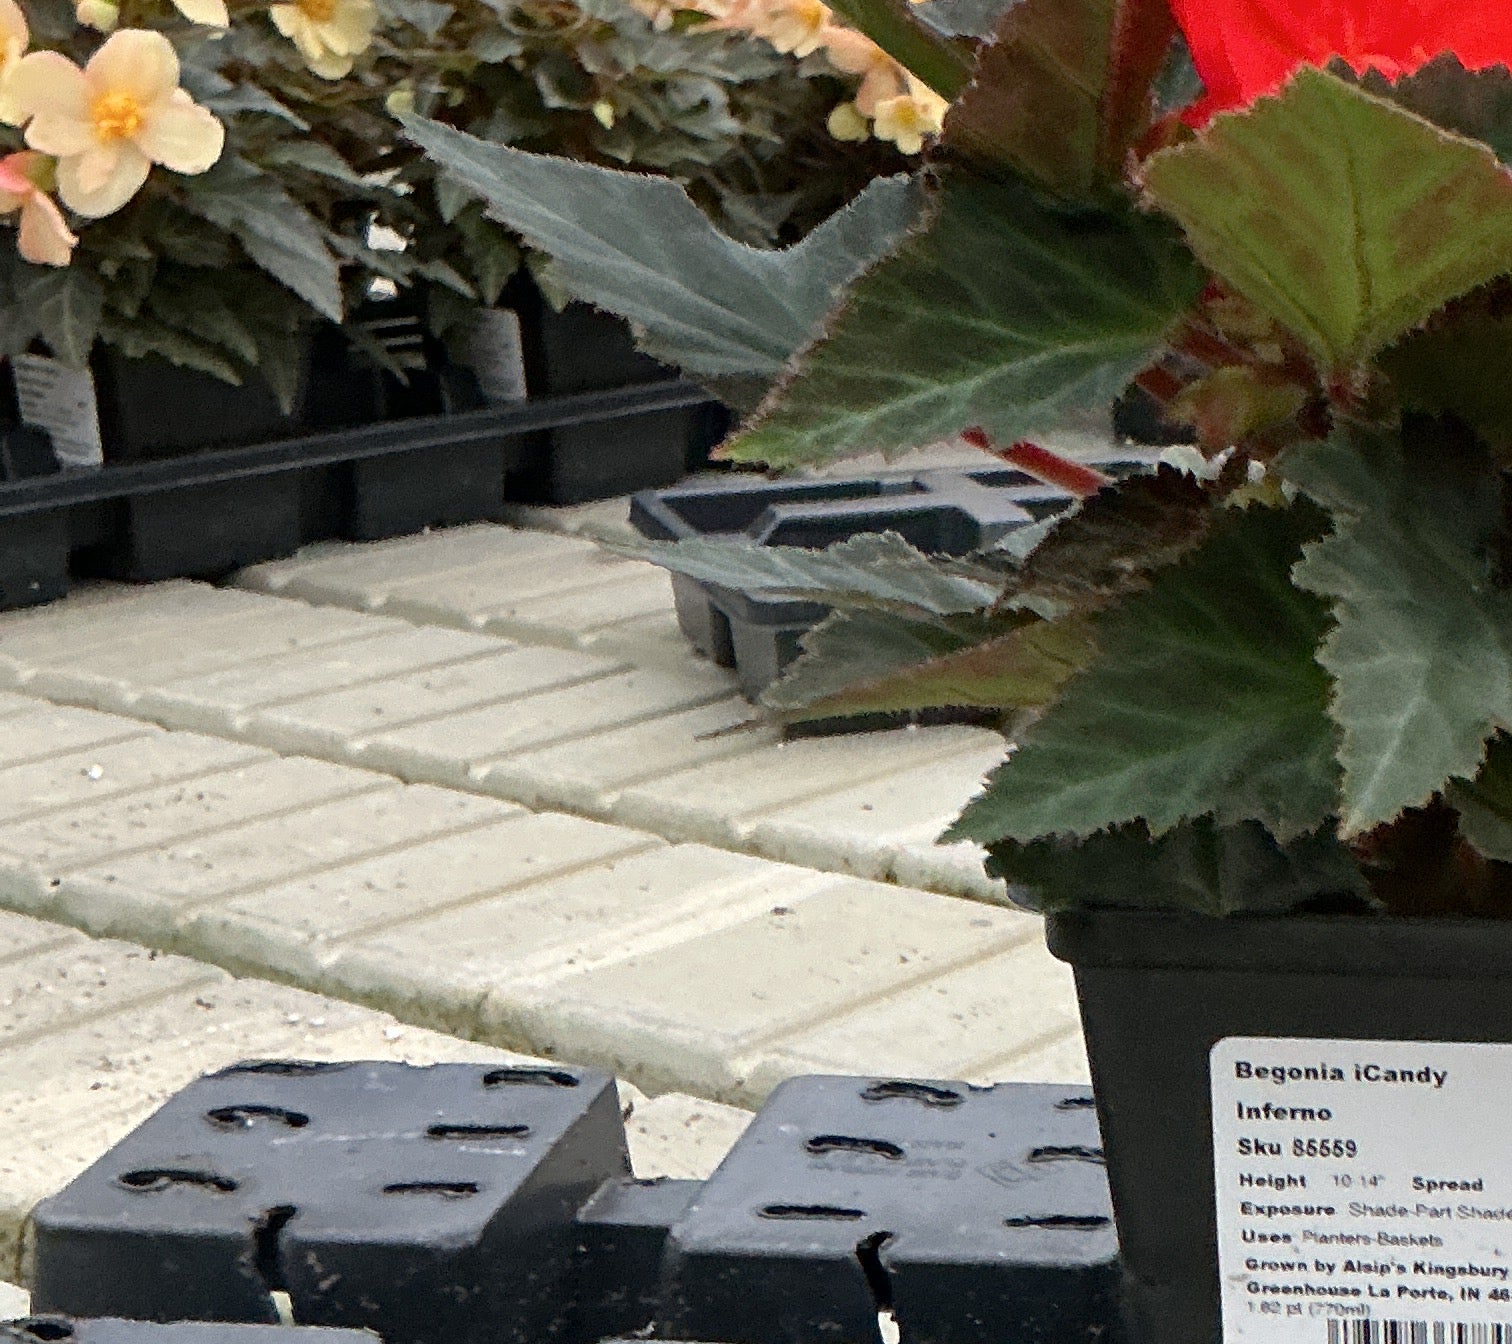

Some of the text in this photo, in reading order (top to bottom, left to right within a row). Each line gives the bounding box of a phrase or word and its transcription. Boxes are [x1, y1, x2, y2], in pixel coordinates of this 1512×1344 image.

[1234, 1060, 1448, 1089] Begonia iCandy
[1236, 1099, 1333, 1121] Inferno
[1237, 1136, 1282, 1156] Sku
[1239, 1172, 1307, 1191] Height
[1412, 1175, 1484, 1194] Spread
[1240, 1200, 1336, 1220] Exposure
[1241, 1228, 1293, 1244] Uses
[1245, 1258, 1308, 1272] Grown
[1314, 1258, 1336, 1276] by
[1412, 1260, 1509, 1281] Kingsbury
[1246, 1281, 1362, 1298] Greenhouse
[1367, 1283, 1391, 1298] La
[1460, 1285, 1481, 1301] IN
